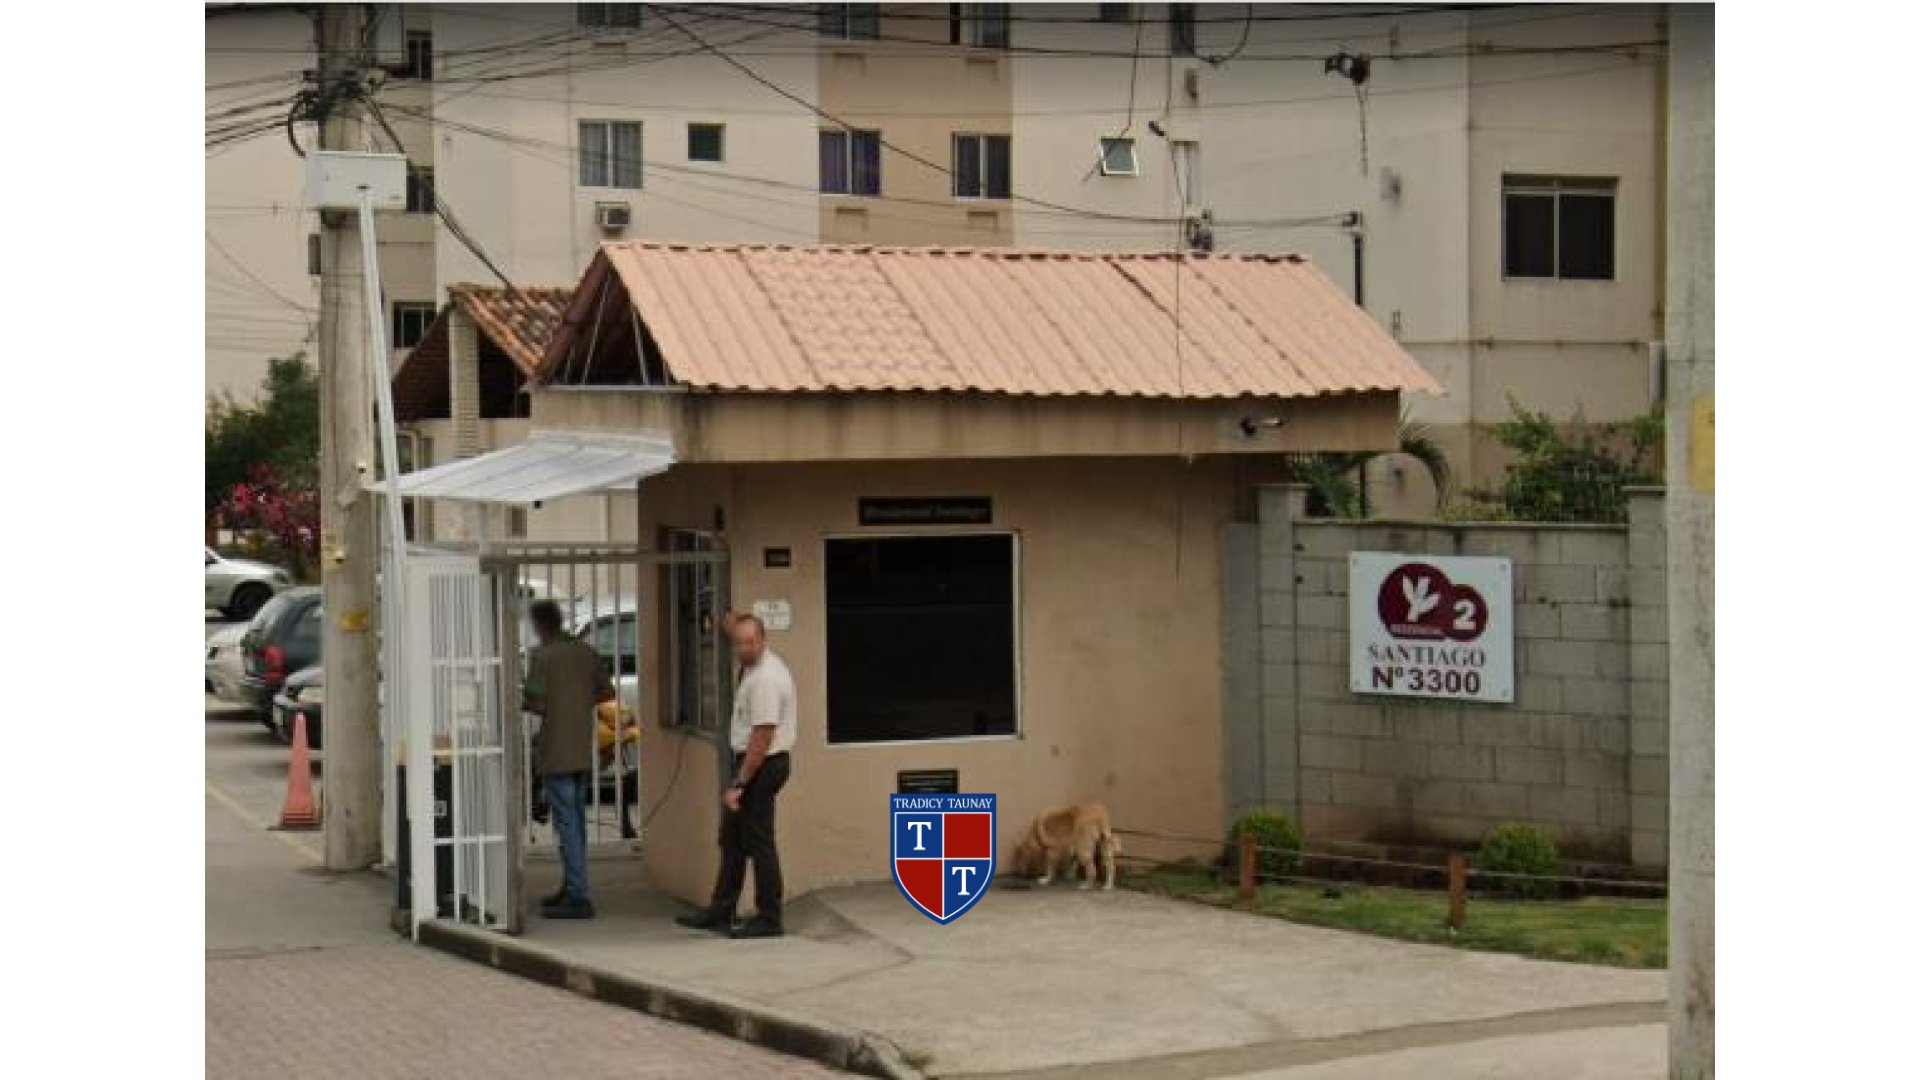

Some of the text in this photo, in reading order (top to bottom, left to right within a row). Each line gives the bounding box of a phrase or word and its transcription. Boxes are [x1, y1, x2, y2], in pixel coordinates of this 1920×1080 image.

[1453, 600, 1476, 630] 2
[1369, 644, 1486, 667] SANTIAGO
[1408, 669, 1481, 694] 3300
